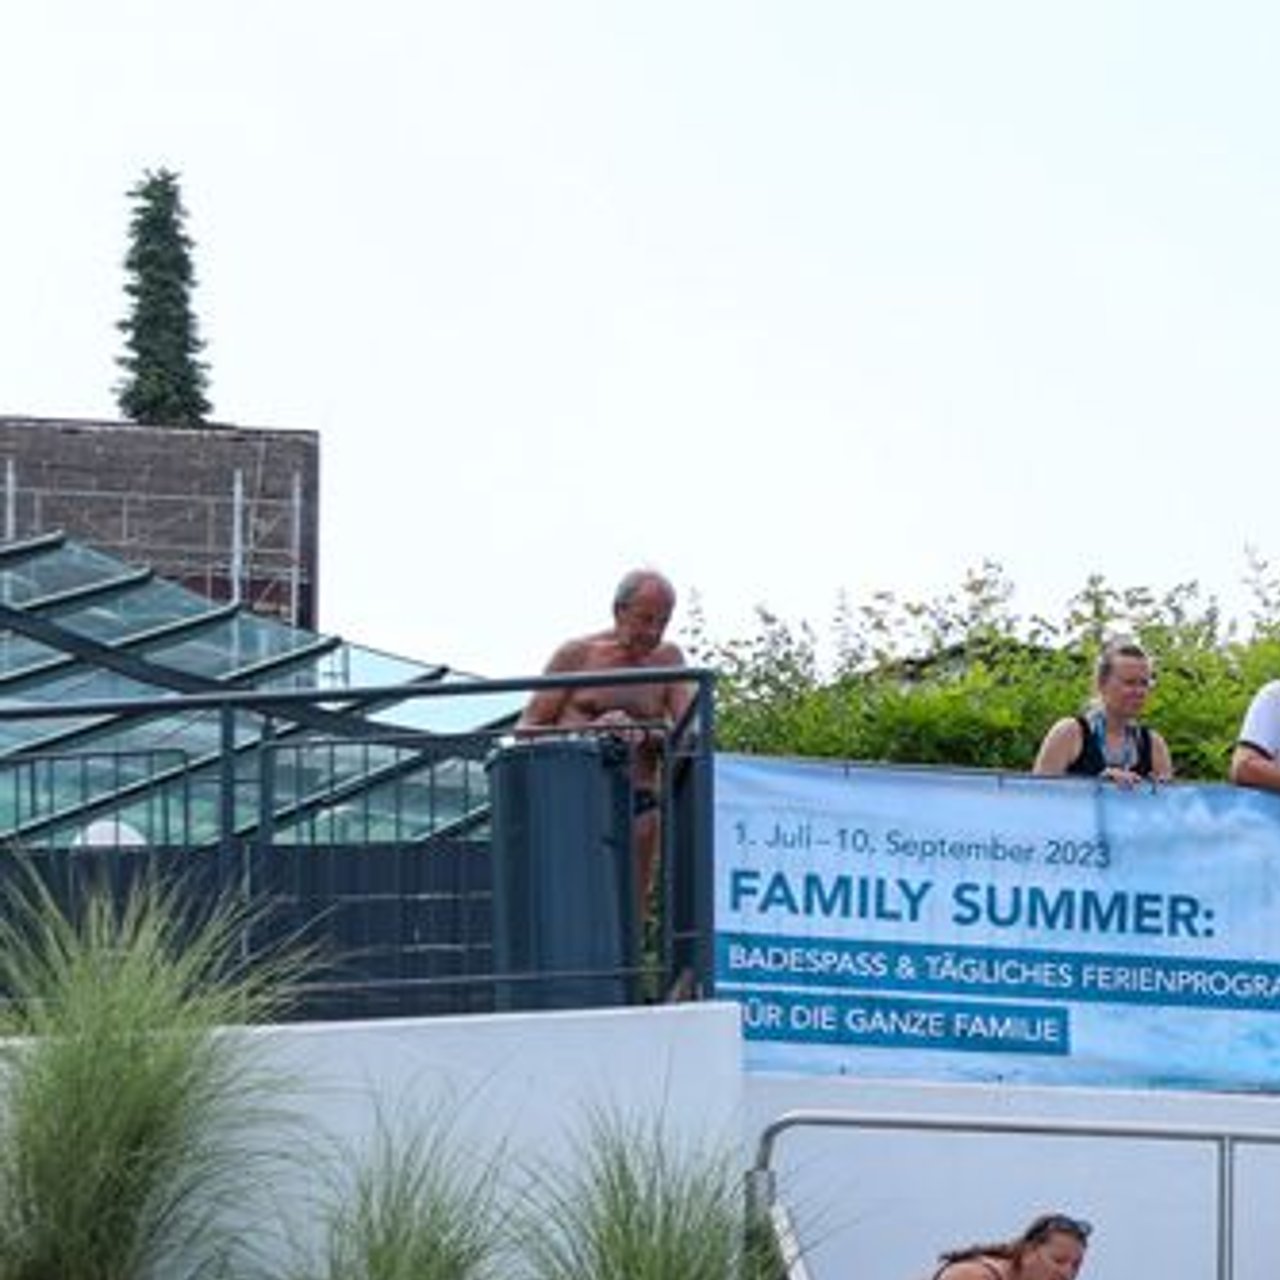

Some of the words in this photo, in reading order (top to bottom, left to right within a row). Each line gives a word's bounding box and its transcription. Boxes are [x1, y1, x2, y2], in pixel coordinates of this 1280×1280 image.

[733, 822, 757, 846] 1.
[885, 829, 1035, 863] September
[1045, 840, 1111, 868] 2023
[731, 870, 933, 922] FAMILY
[951, 882, 1215, 937] SUMMER:
[729, 945, 888, 977] BADESPASS
[896, 956, 916, 979] &
[924, 953, 1073, 988] TÄGLICHES
[741, 998, 782, 1028] ÜR
[790, 1005, 836, 1030] DIE
[845, 1008, 944, 1037] GANZE
